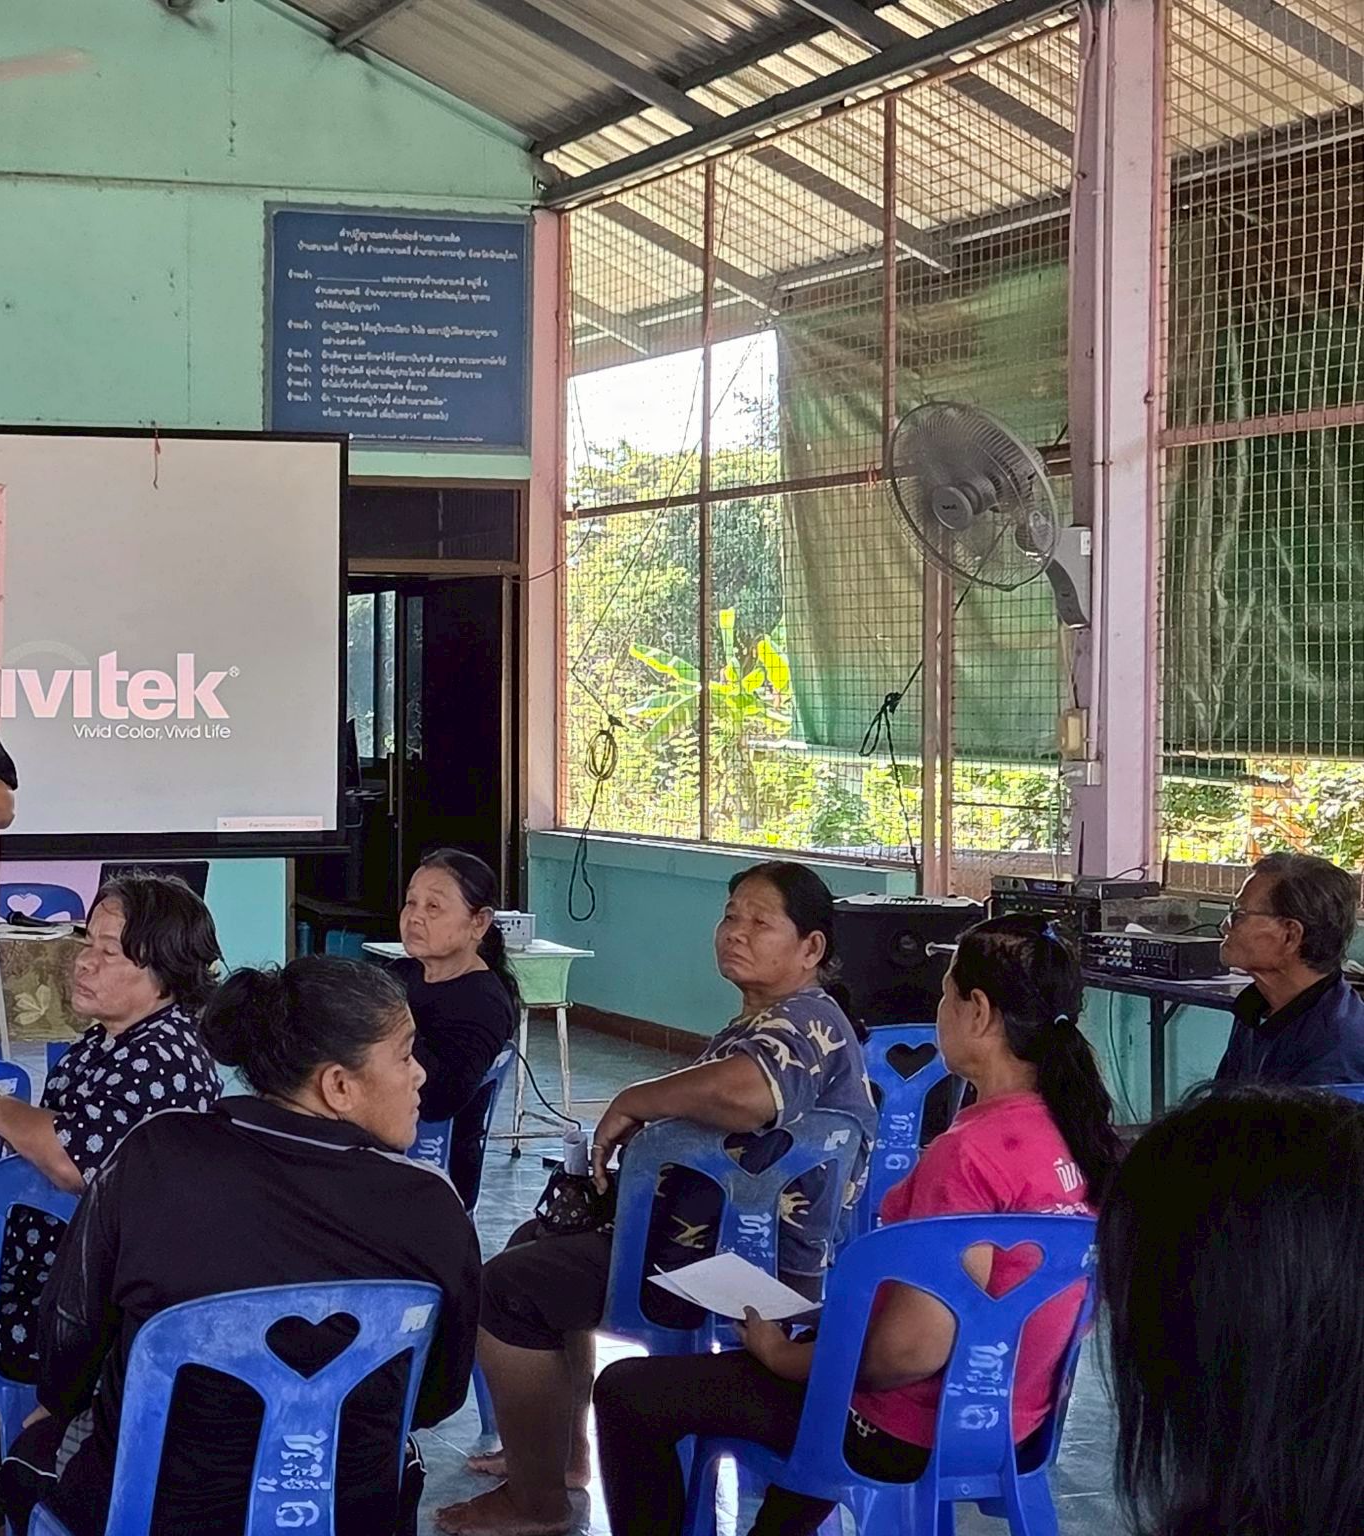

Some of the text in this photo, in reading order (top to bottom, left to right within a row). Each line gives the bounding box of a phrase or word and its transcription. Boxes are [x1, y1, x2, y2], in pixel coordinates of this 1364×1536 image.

[73, 724, 232, 741] Vivid Color, Vivid Life
[275, 1499, 321, 1528] 6
